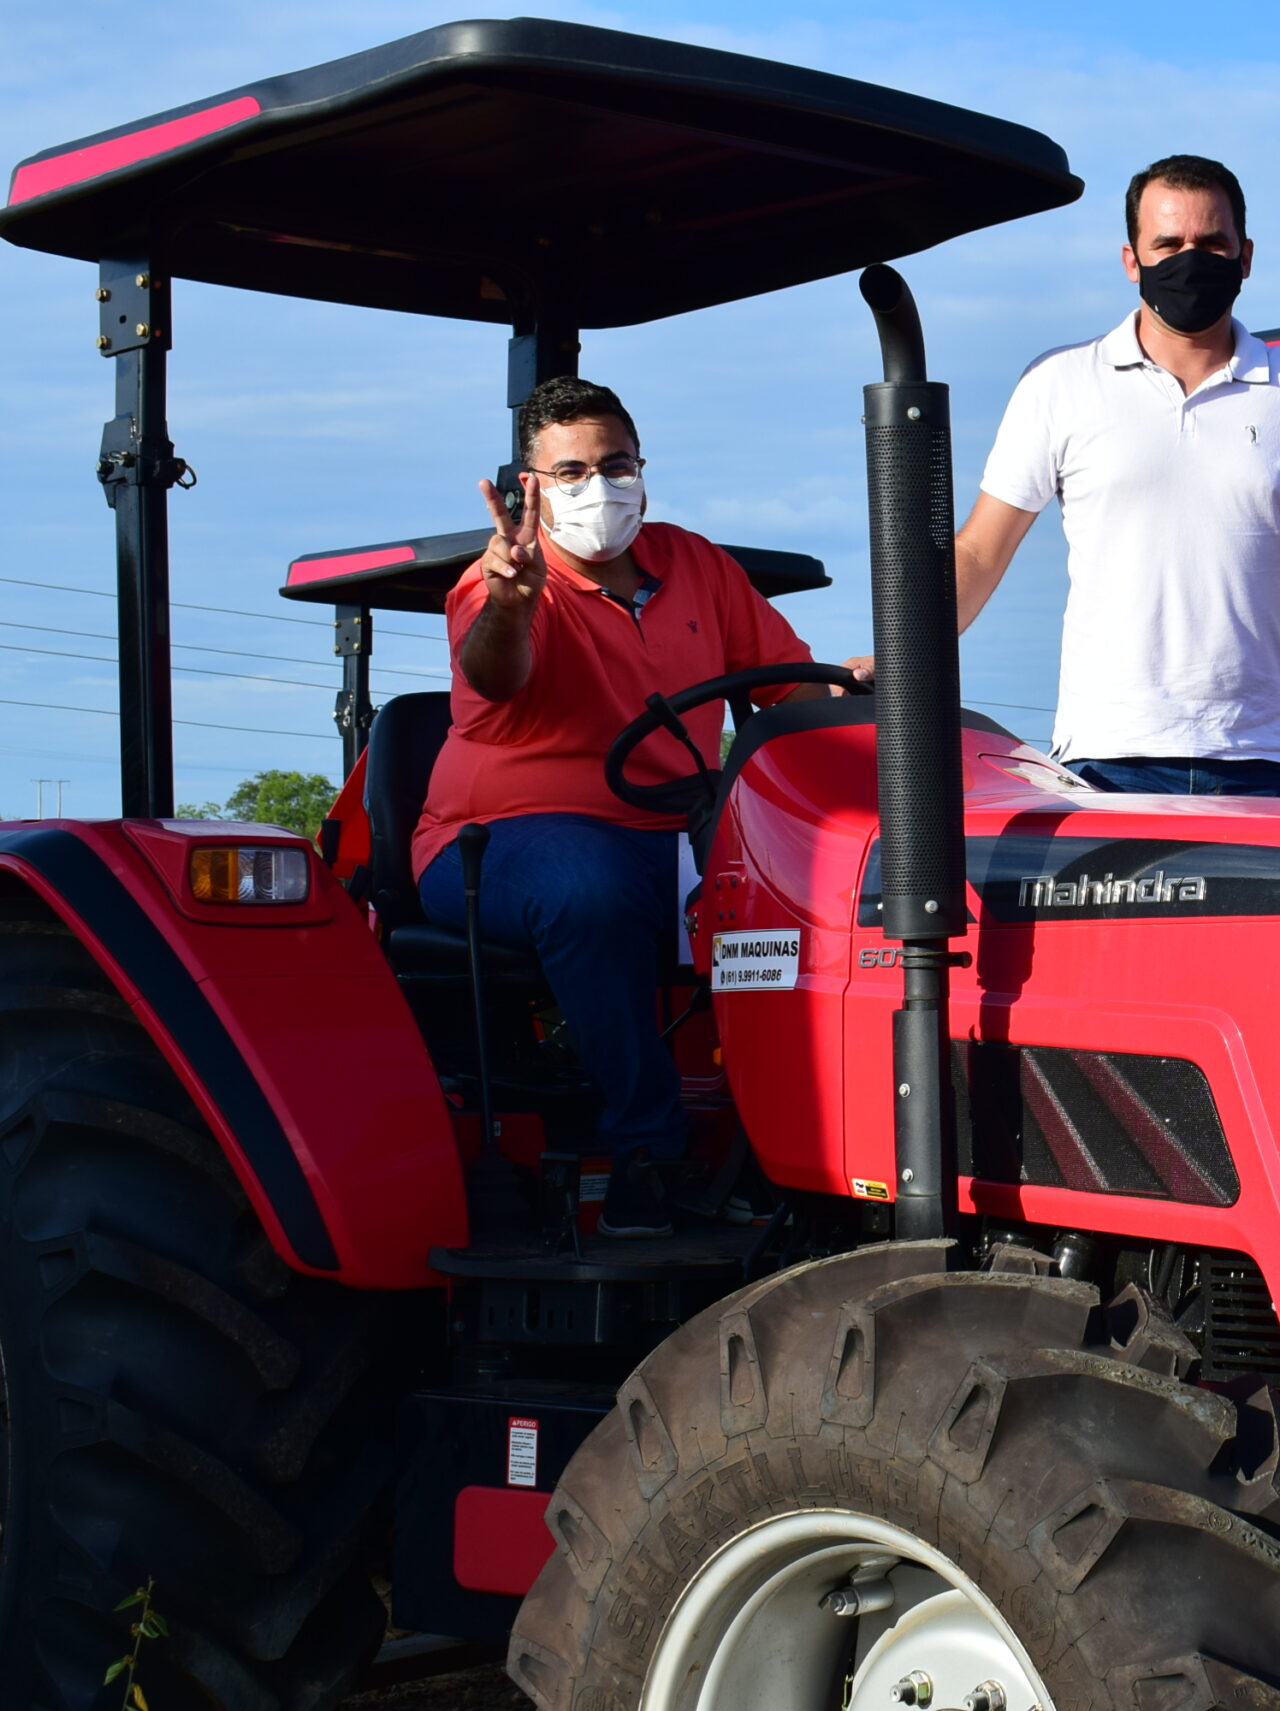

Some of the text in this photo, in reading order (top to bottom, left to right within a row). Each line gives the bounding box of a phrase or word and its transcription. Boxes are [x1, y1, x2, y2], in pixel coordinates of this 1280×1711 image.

[1018, 870, 1207, 908] Mahindra
[721, 941, 798, 959] DNM MAQUINAS
[858, 948, 903, 969] 60
[725, 969, 783, 986] (61) 9.9911-6086
[607, 1450, 786, 1642] SHAKTI
